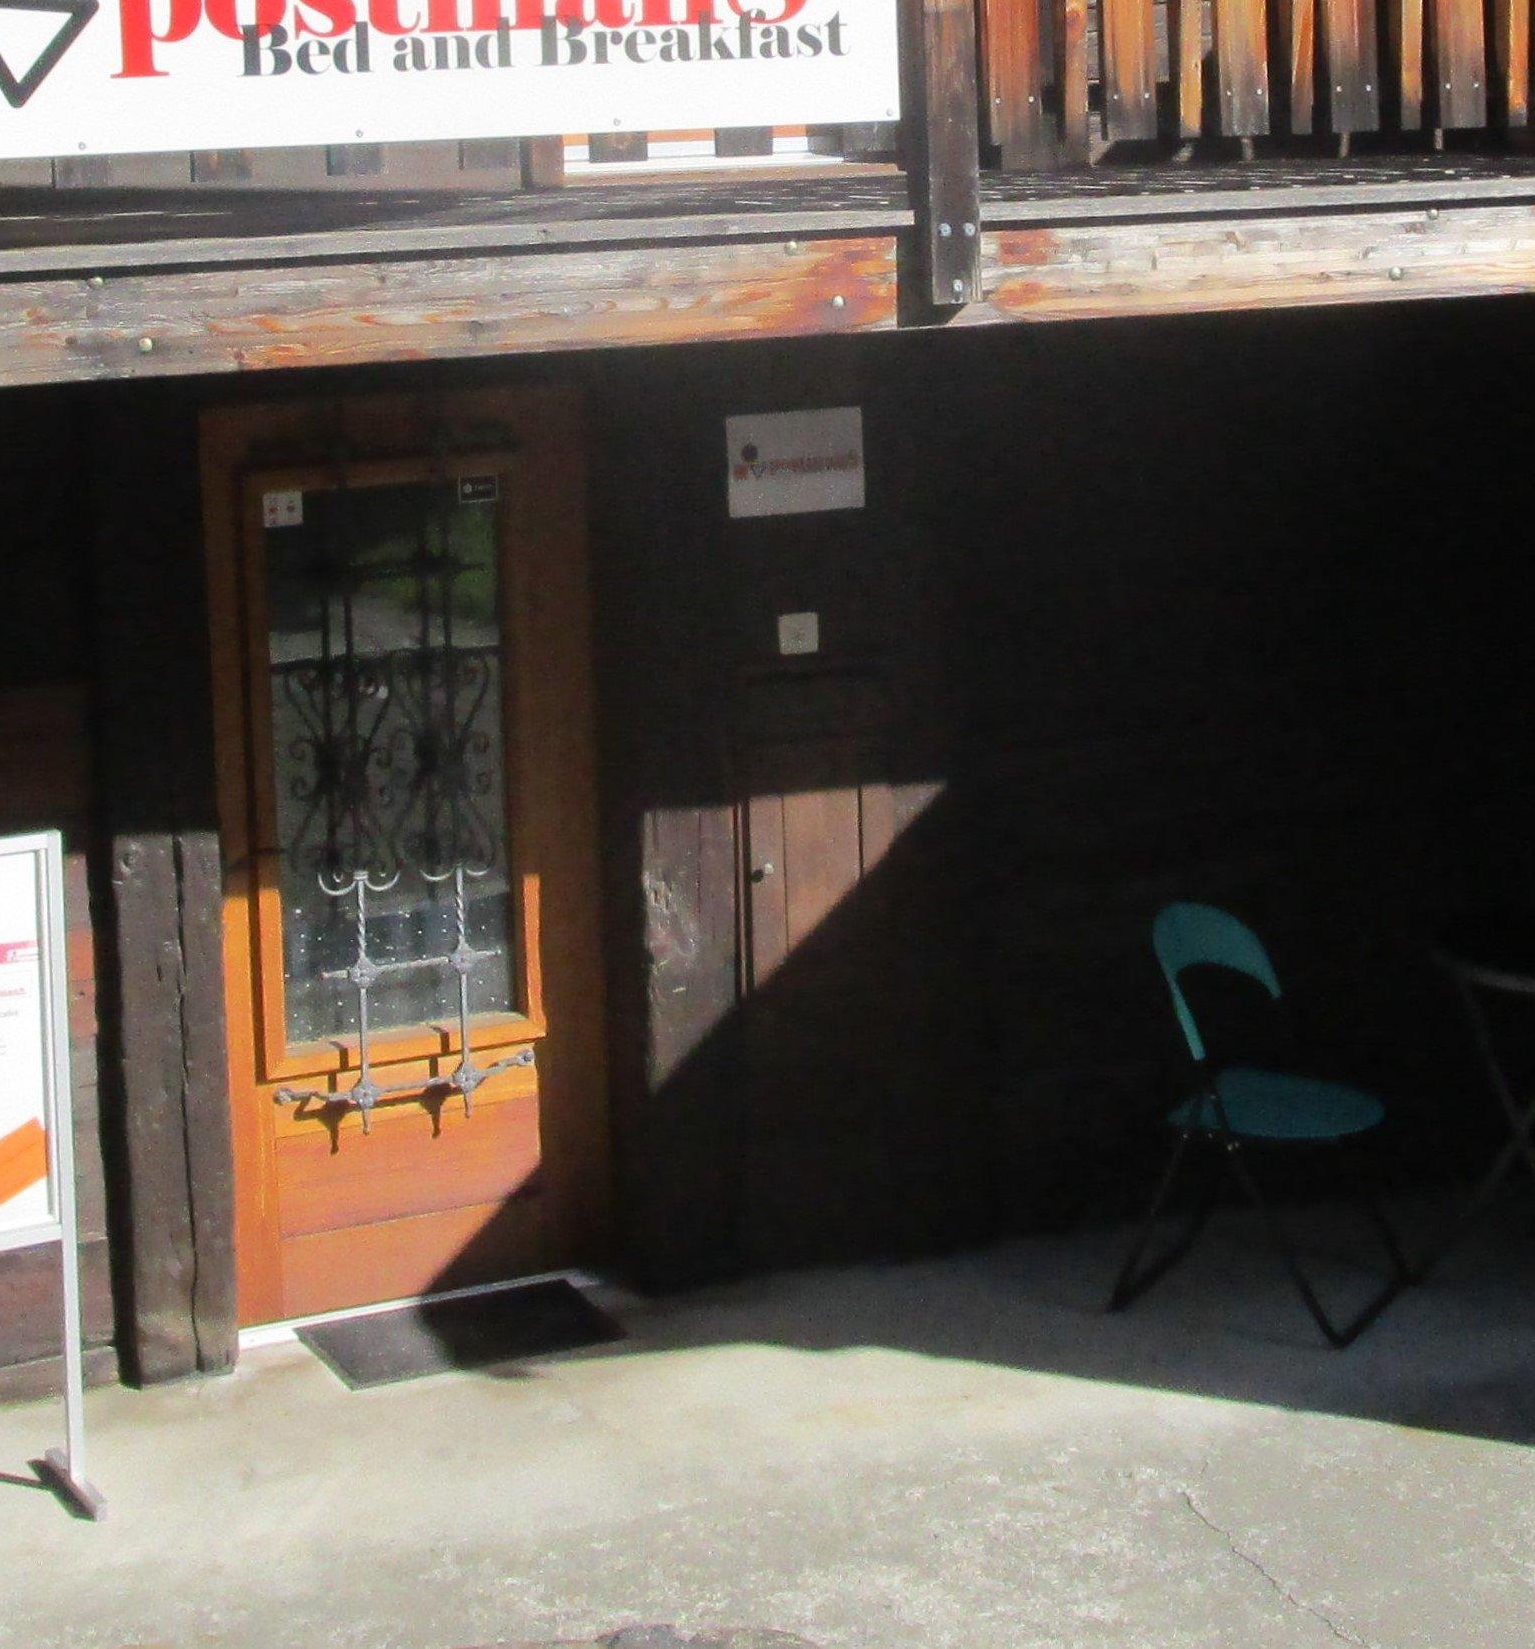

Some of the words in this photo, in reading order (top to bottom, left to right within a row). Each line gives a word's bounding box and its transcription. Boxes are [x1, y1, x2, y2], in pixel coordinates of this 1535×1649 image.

[236, 20, 373, 77] Bed
[392, 16, 514, 72] and
[534, 8, 851, 67] Breakfast
